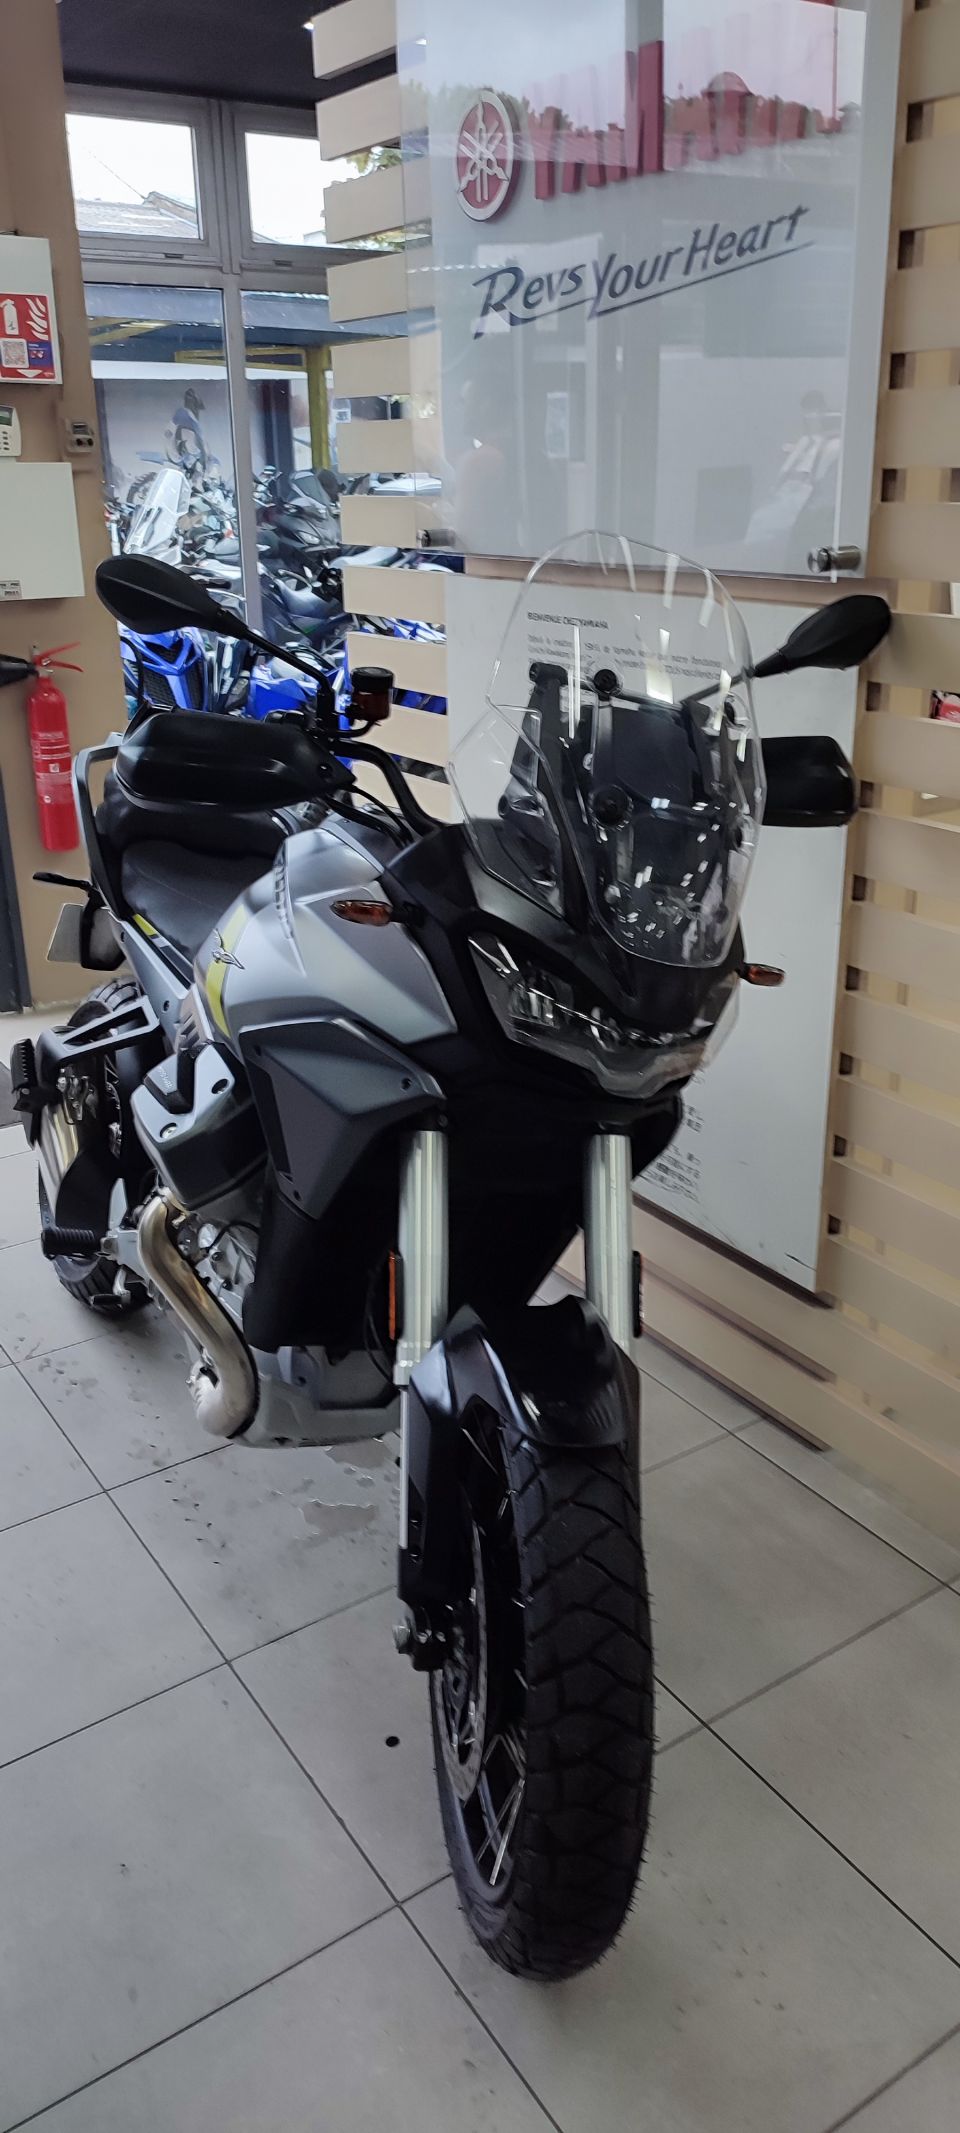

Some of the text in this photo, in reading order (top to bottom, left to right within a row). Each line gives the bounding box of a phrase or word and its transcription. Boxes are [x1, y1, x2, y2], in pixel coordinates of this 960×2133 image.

[472, 204, 811, 340] Revs Your Heart
